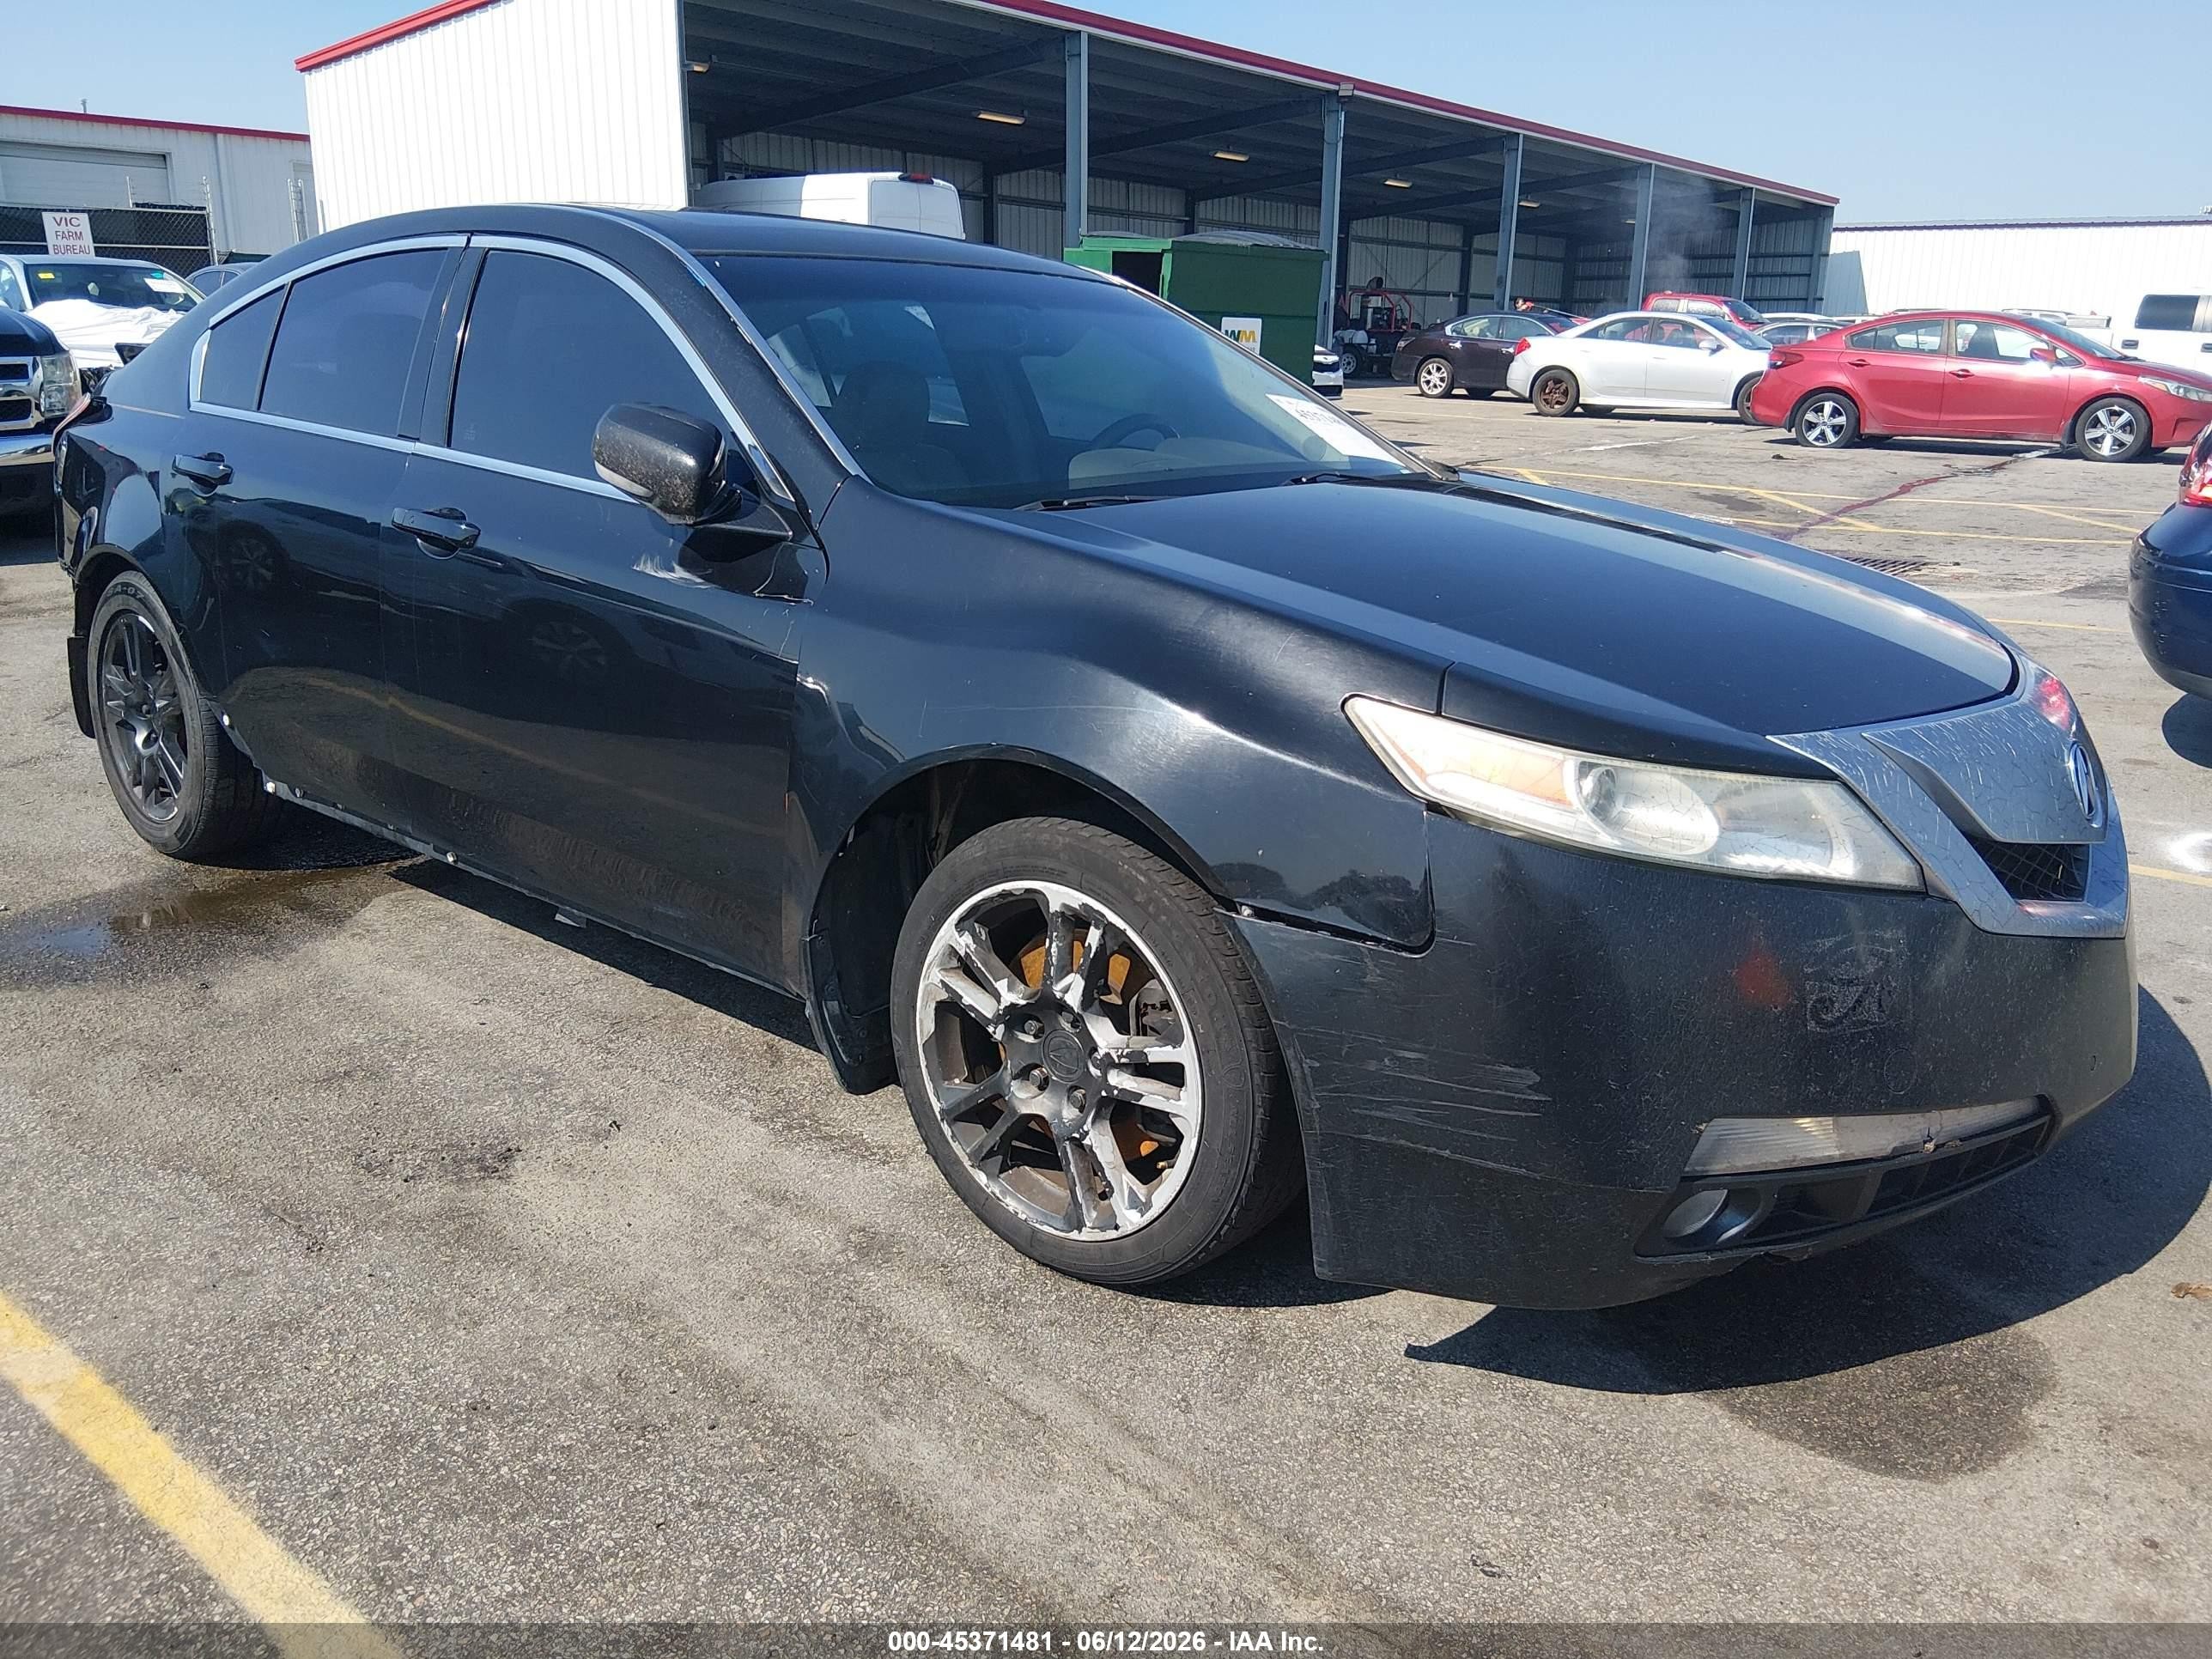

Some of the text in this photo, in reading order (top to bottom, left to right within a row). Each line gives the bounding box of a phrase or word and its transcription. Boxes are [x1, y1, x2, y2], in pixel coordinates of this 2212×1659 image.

[52, 216, 81, 227] VIC
[55, 230, 83, 240] FARM
[52, 244, 90, 255] BUREAU
[1224, 330, 1255, 343] WM
